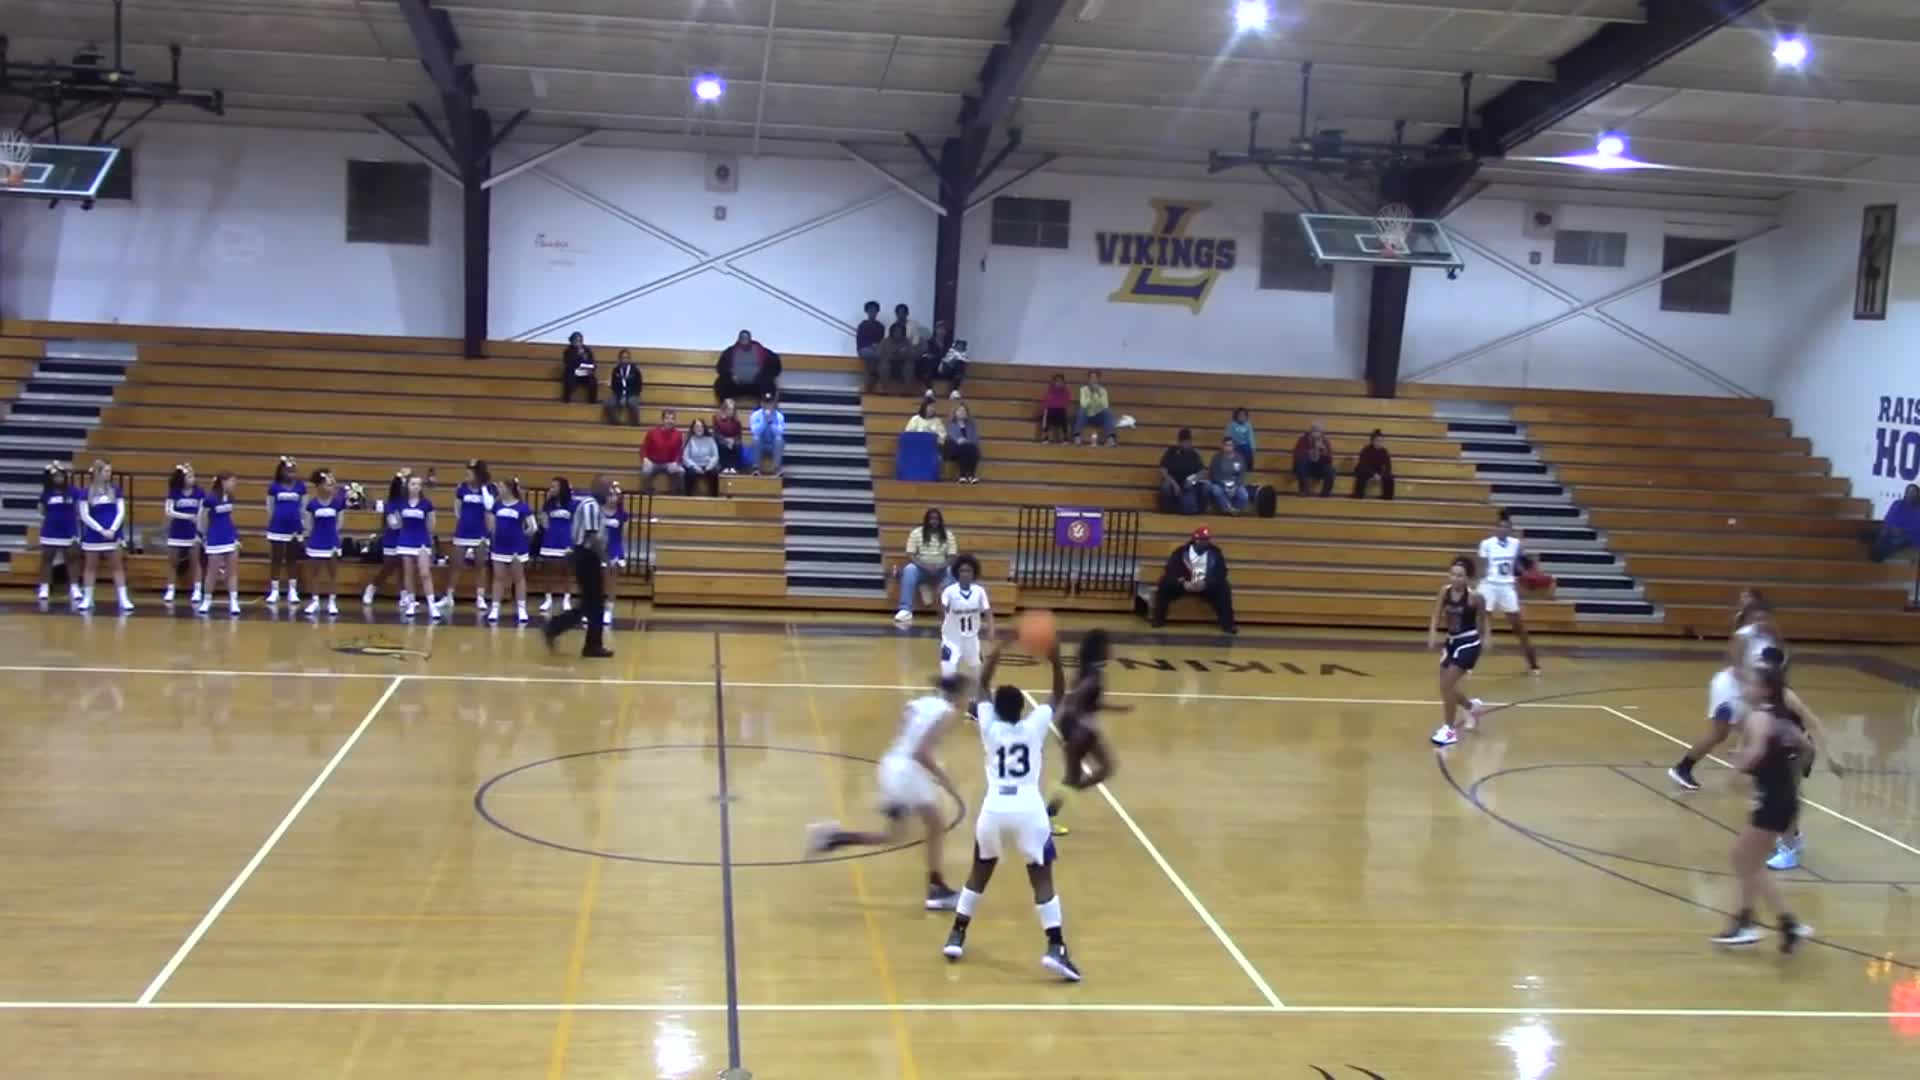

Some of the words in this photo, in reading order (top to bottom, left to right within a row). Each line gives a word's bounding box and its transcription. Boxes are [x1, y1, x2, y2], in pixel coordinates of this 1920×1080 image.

[1096, 231, 1237, 270] VIKINGS
[1872, 428, 1920, 481] HO
[960, 615, 973, 632] 11
[995, 743, 1031, 779] 13
